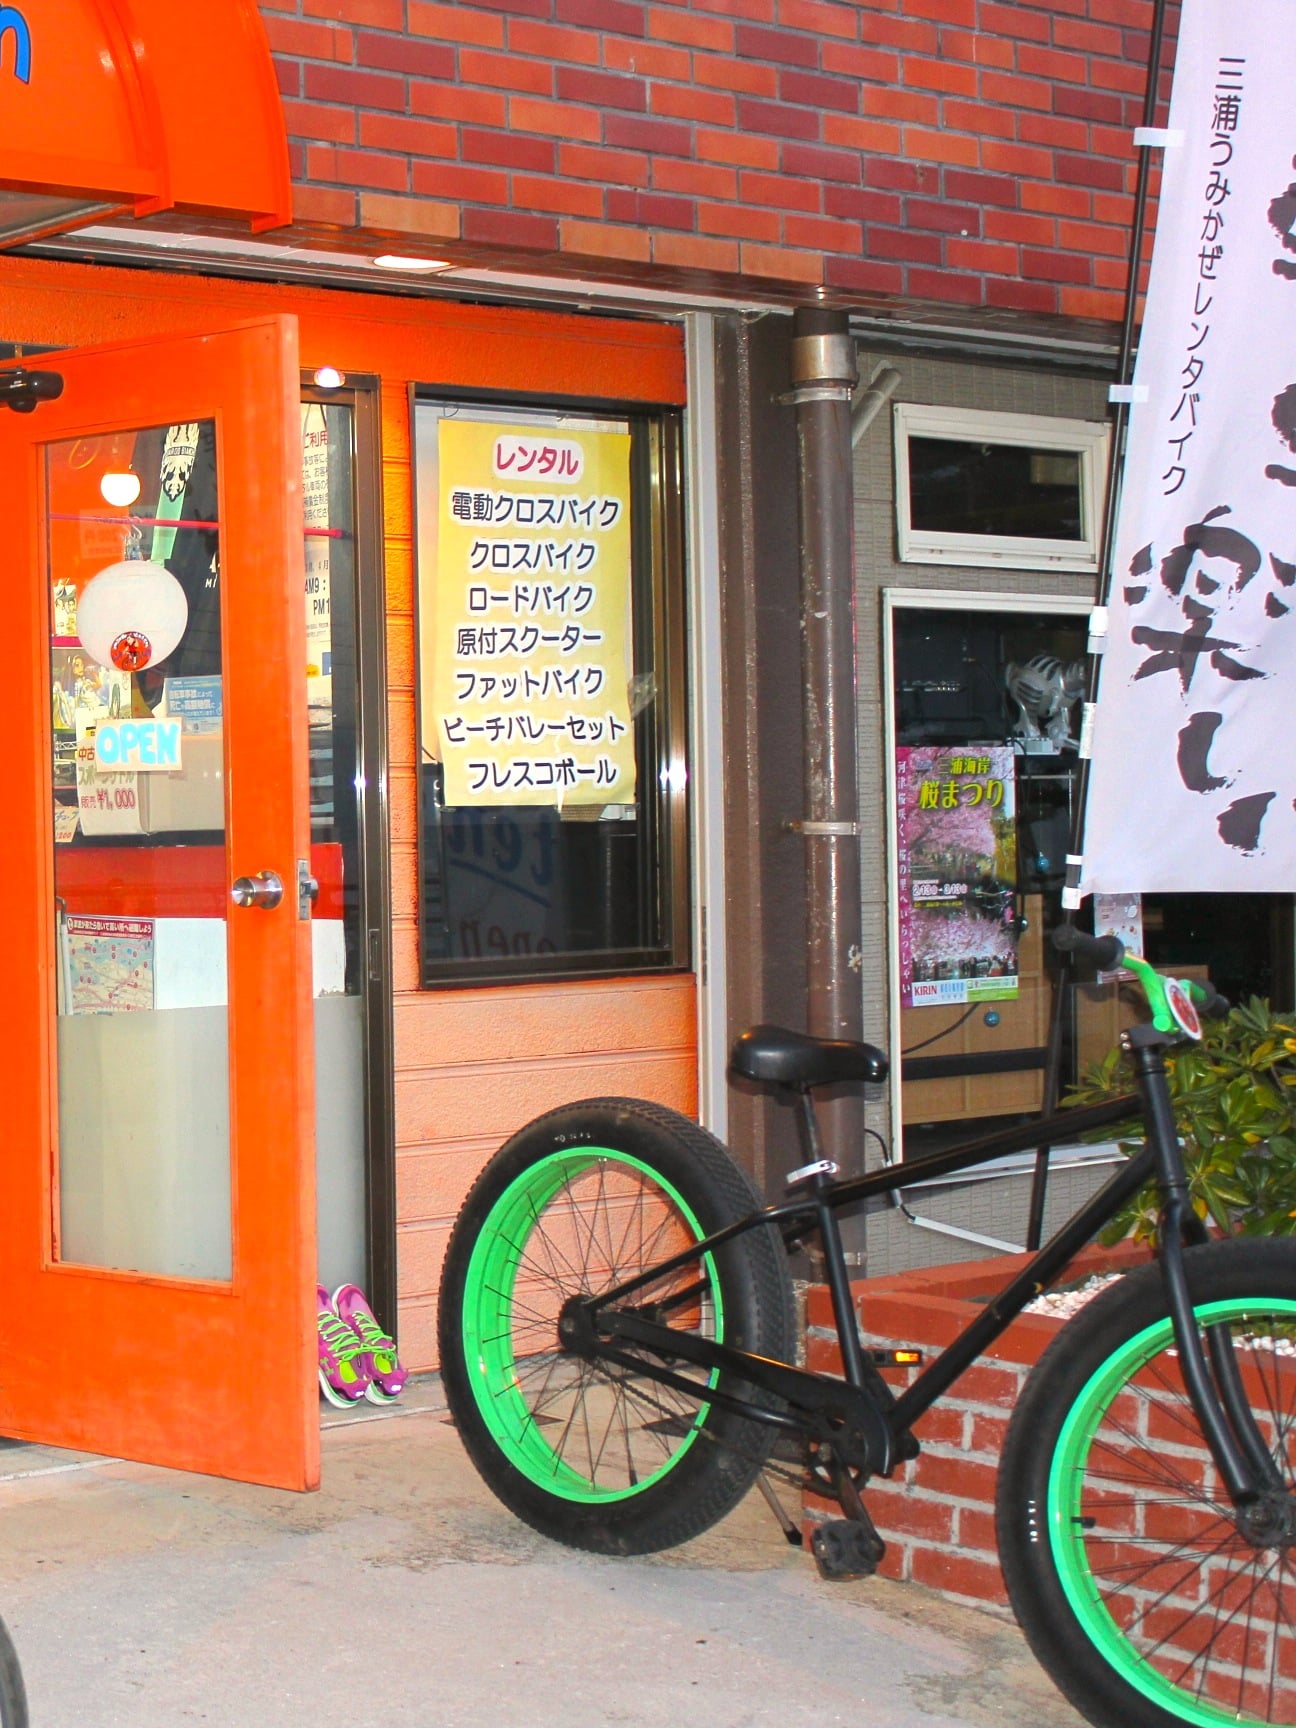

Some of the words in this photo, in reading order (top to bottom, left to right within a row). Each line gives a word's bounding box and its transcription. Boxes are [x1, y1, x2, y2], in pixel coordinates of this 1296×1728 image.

[1161, 57, 1246, 496] 三浦うみかぜレンタバイク
[497, 443, 579, 475] レンタル
[452, 491, 619, 526] 電動クロスバイク
[470, 541, 596, 569] クロスバイク
[470, 585, 593, 612] ロードバイク
[457, 625, 602, 655] 原付スクーター
[457, 668, 603, 699] ファットバイク
[1124, 504, 1277, 857] 楽しい
[96, 721, 180, 764] OPEN
[444, 715, 625, 743] ビーチバレーセット
[469, 757, 616, 789] フレスコボール
[938, 757, 992, 775] 三浦海岸
[919, 779, 1004, 809] 桜まつり
[914, 985, 938, 996] KIRIN
